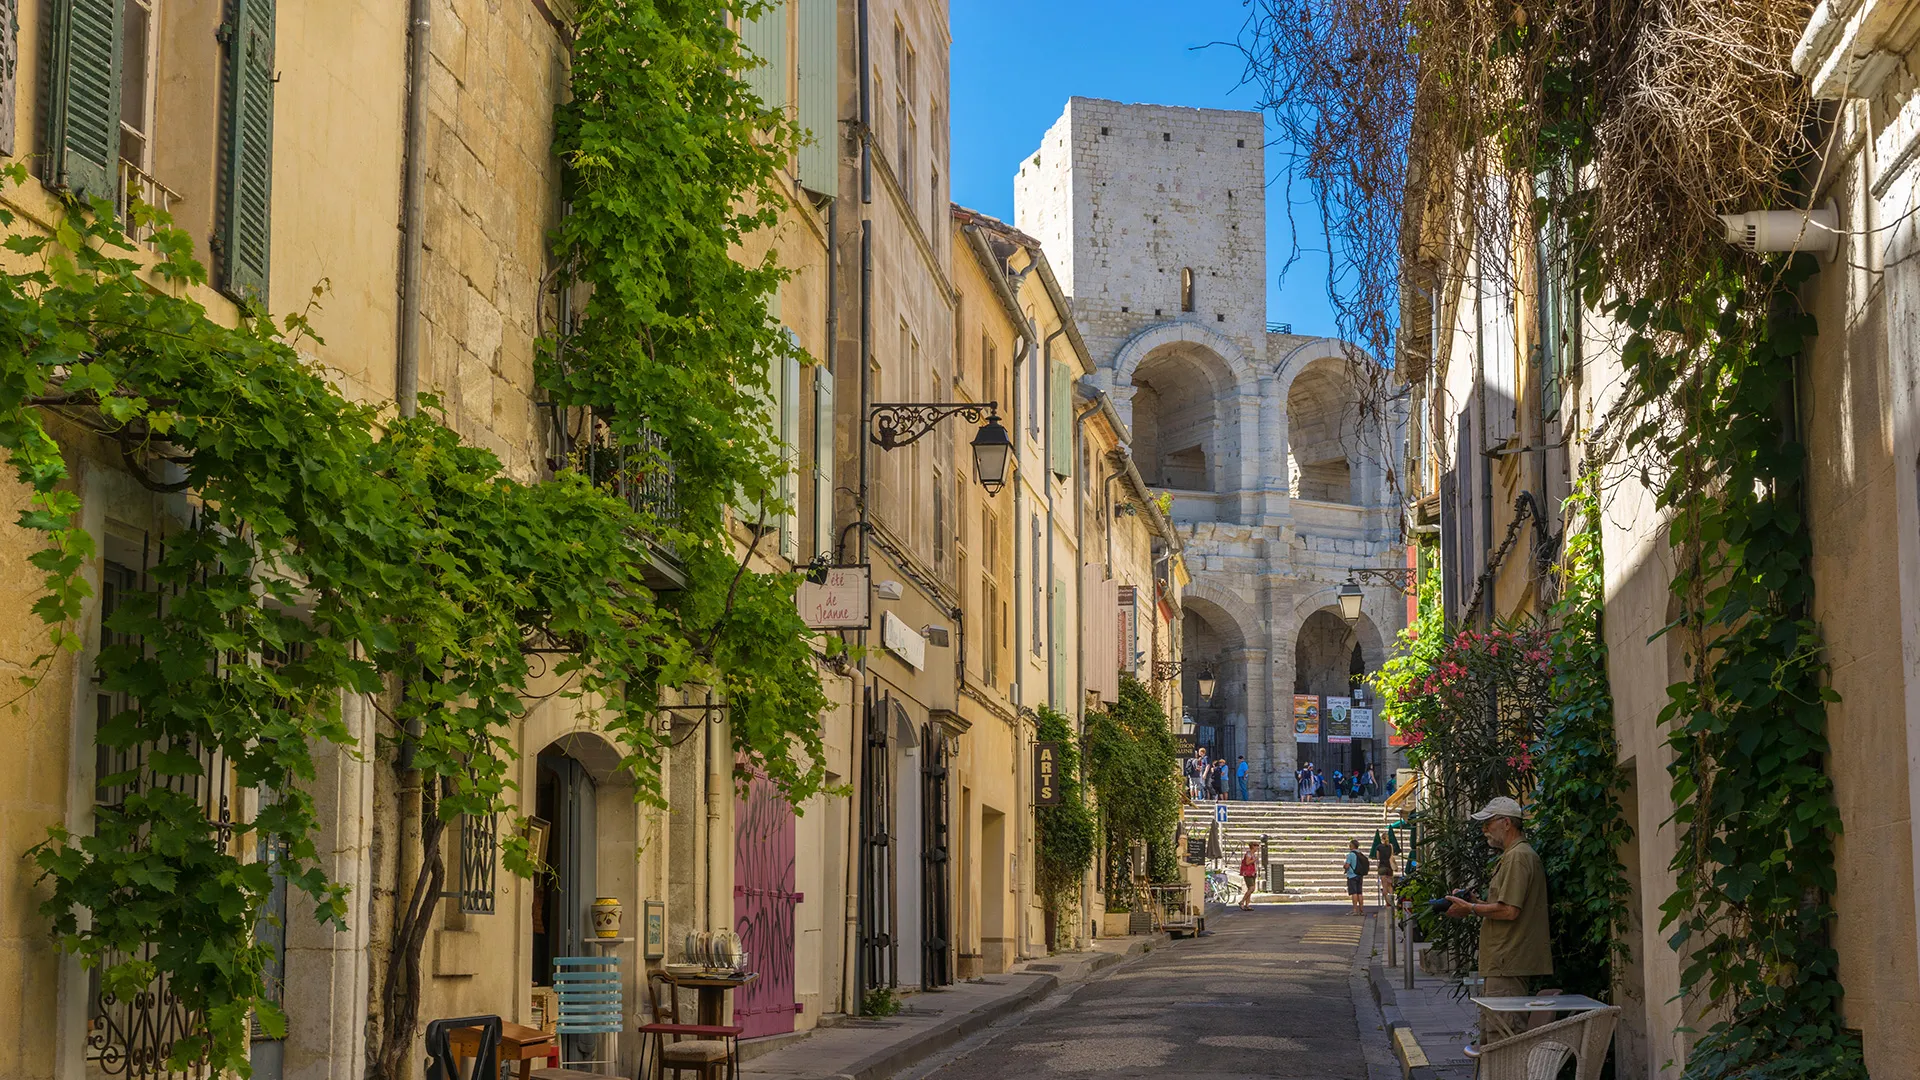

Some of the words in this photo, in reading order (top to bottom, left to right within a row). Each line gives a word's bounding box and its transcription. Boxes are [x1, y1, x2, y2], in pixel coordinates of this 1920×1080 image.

[826, 592, 838, 607] de
[815, 604, 849, 624] Jeanne
[1040, 748, 1053, 799] ARTS
